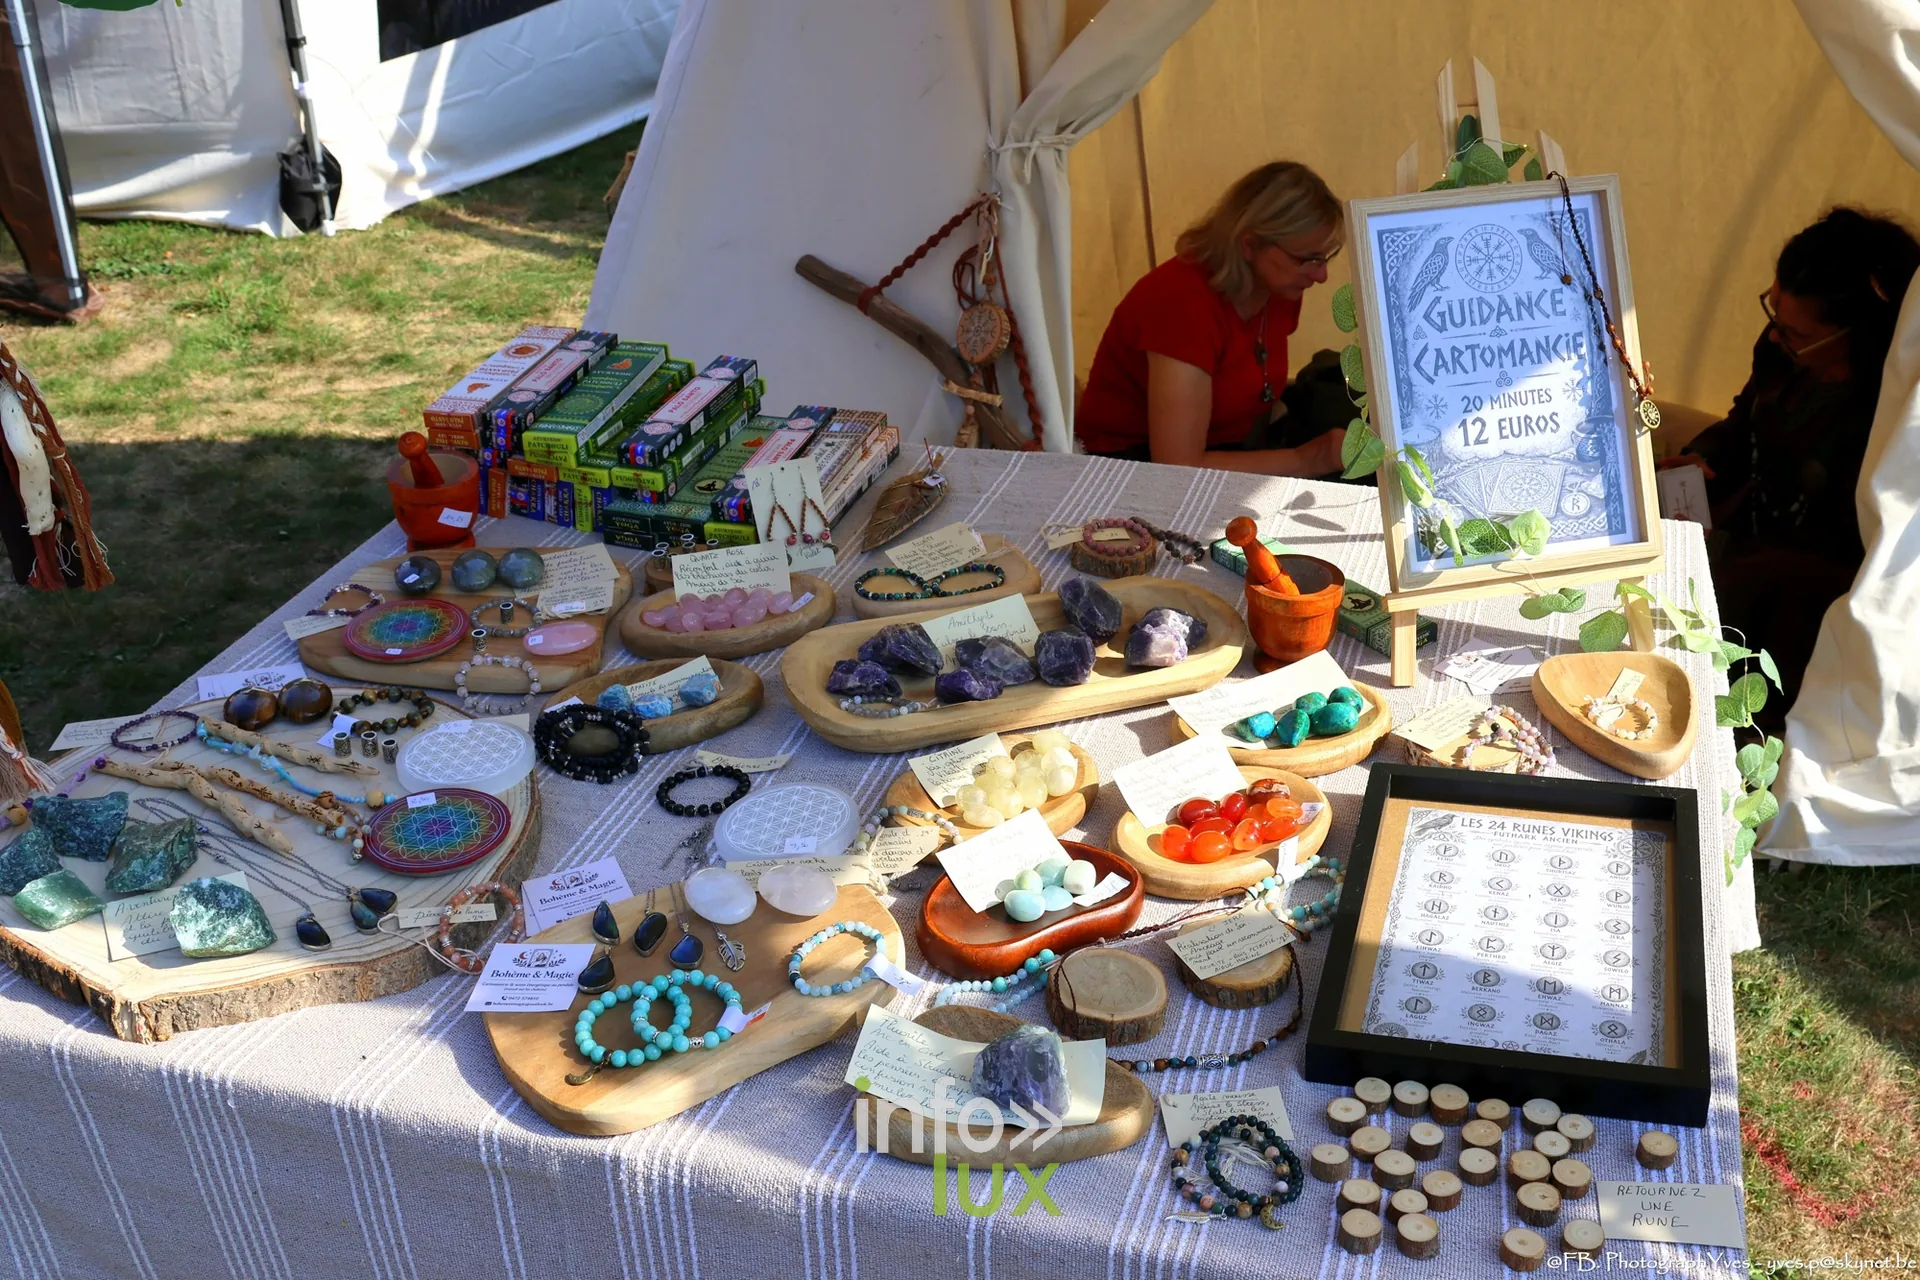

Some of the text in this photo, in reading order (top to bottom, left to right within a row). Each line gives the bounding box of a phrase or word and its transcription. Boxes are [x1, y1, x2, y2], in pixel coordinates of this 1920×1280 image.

[1422, 287, 1568, 334] GUIDANCE
[1412, 331, 1588, 386] CARTOMANCIE
[1461, 387, 1553, 413] 20 MINUTES
[1456, 411, 1560, 448] 12 EUROS
[1461, 817, 1614, 842] LES 24 RUNES VIKINGS
[1493, 831, 1537, 840] FUTHARK
[1543, 836, 1578, 844] ANCIEN
[532, 970, 542, 979] &
[543, 970, 574, 980] Magie
[1471, 986, 1501, 994] BERKANO
[1405, 1013, 1428, 1021] LAGUZ
[1467, 1021, 1495, 1029] INGWAZ
[1600, 1037, 1626, 1045] OTHALA
[1616, 1184, 1706, 1199] RETOURNEZ
[1640, 1200, 1674, 1212] UNE
[1632, 1215, 1689, 1228] RUNE
